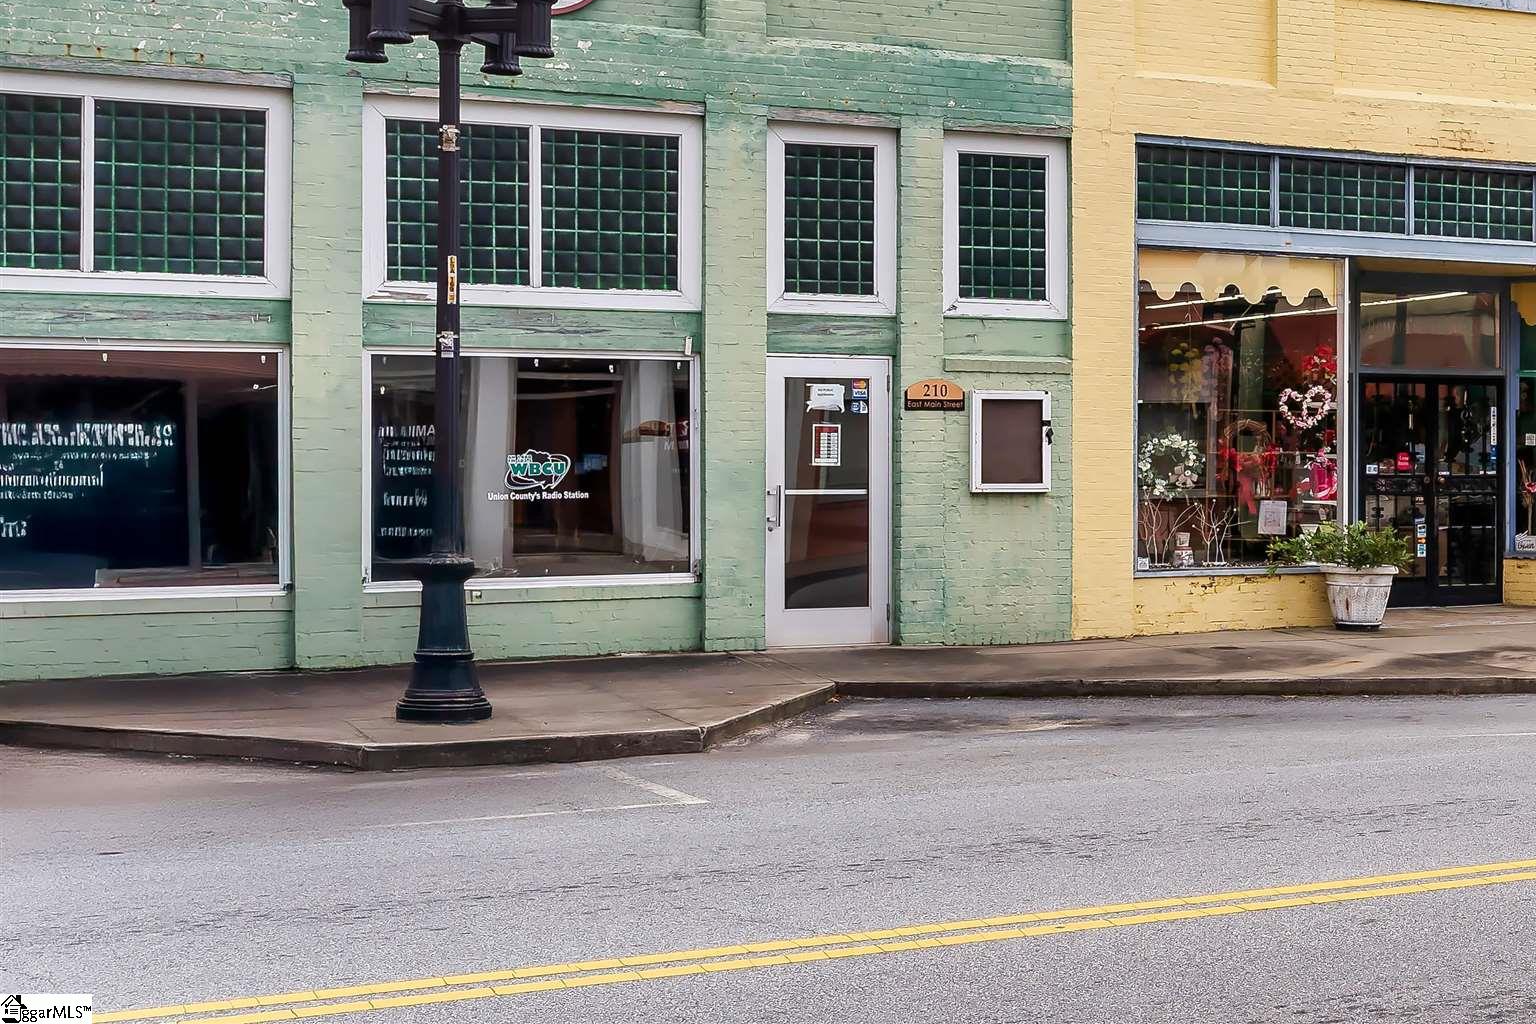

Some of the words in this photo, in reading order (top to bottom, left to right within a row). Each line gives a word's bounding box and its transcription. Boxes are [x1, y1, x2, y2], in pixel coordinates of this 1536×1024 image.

[923, 384, 948, 397] 210
[907, 400, 922, 408] East
[923, 400, 942, 408] Main
[943, 400, 963, 408] Street
[510, 461, 567, 477] WBCU
[487, 491, 509, 501] Union
[510, 491, 541, 502] County's
[541, 490, 562, 500] Radio
[563, 490, 589, 499] Station
